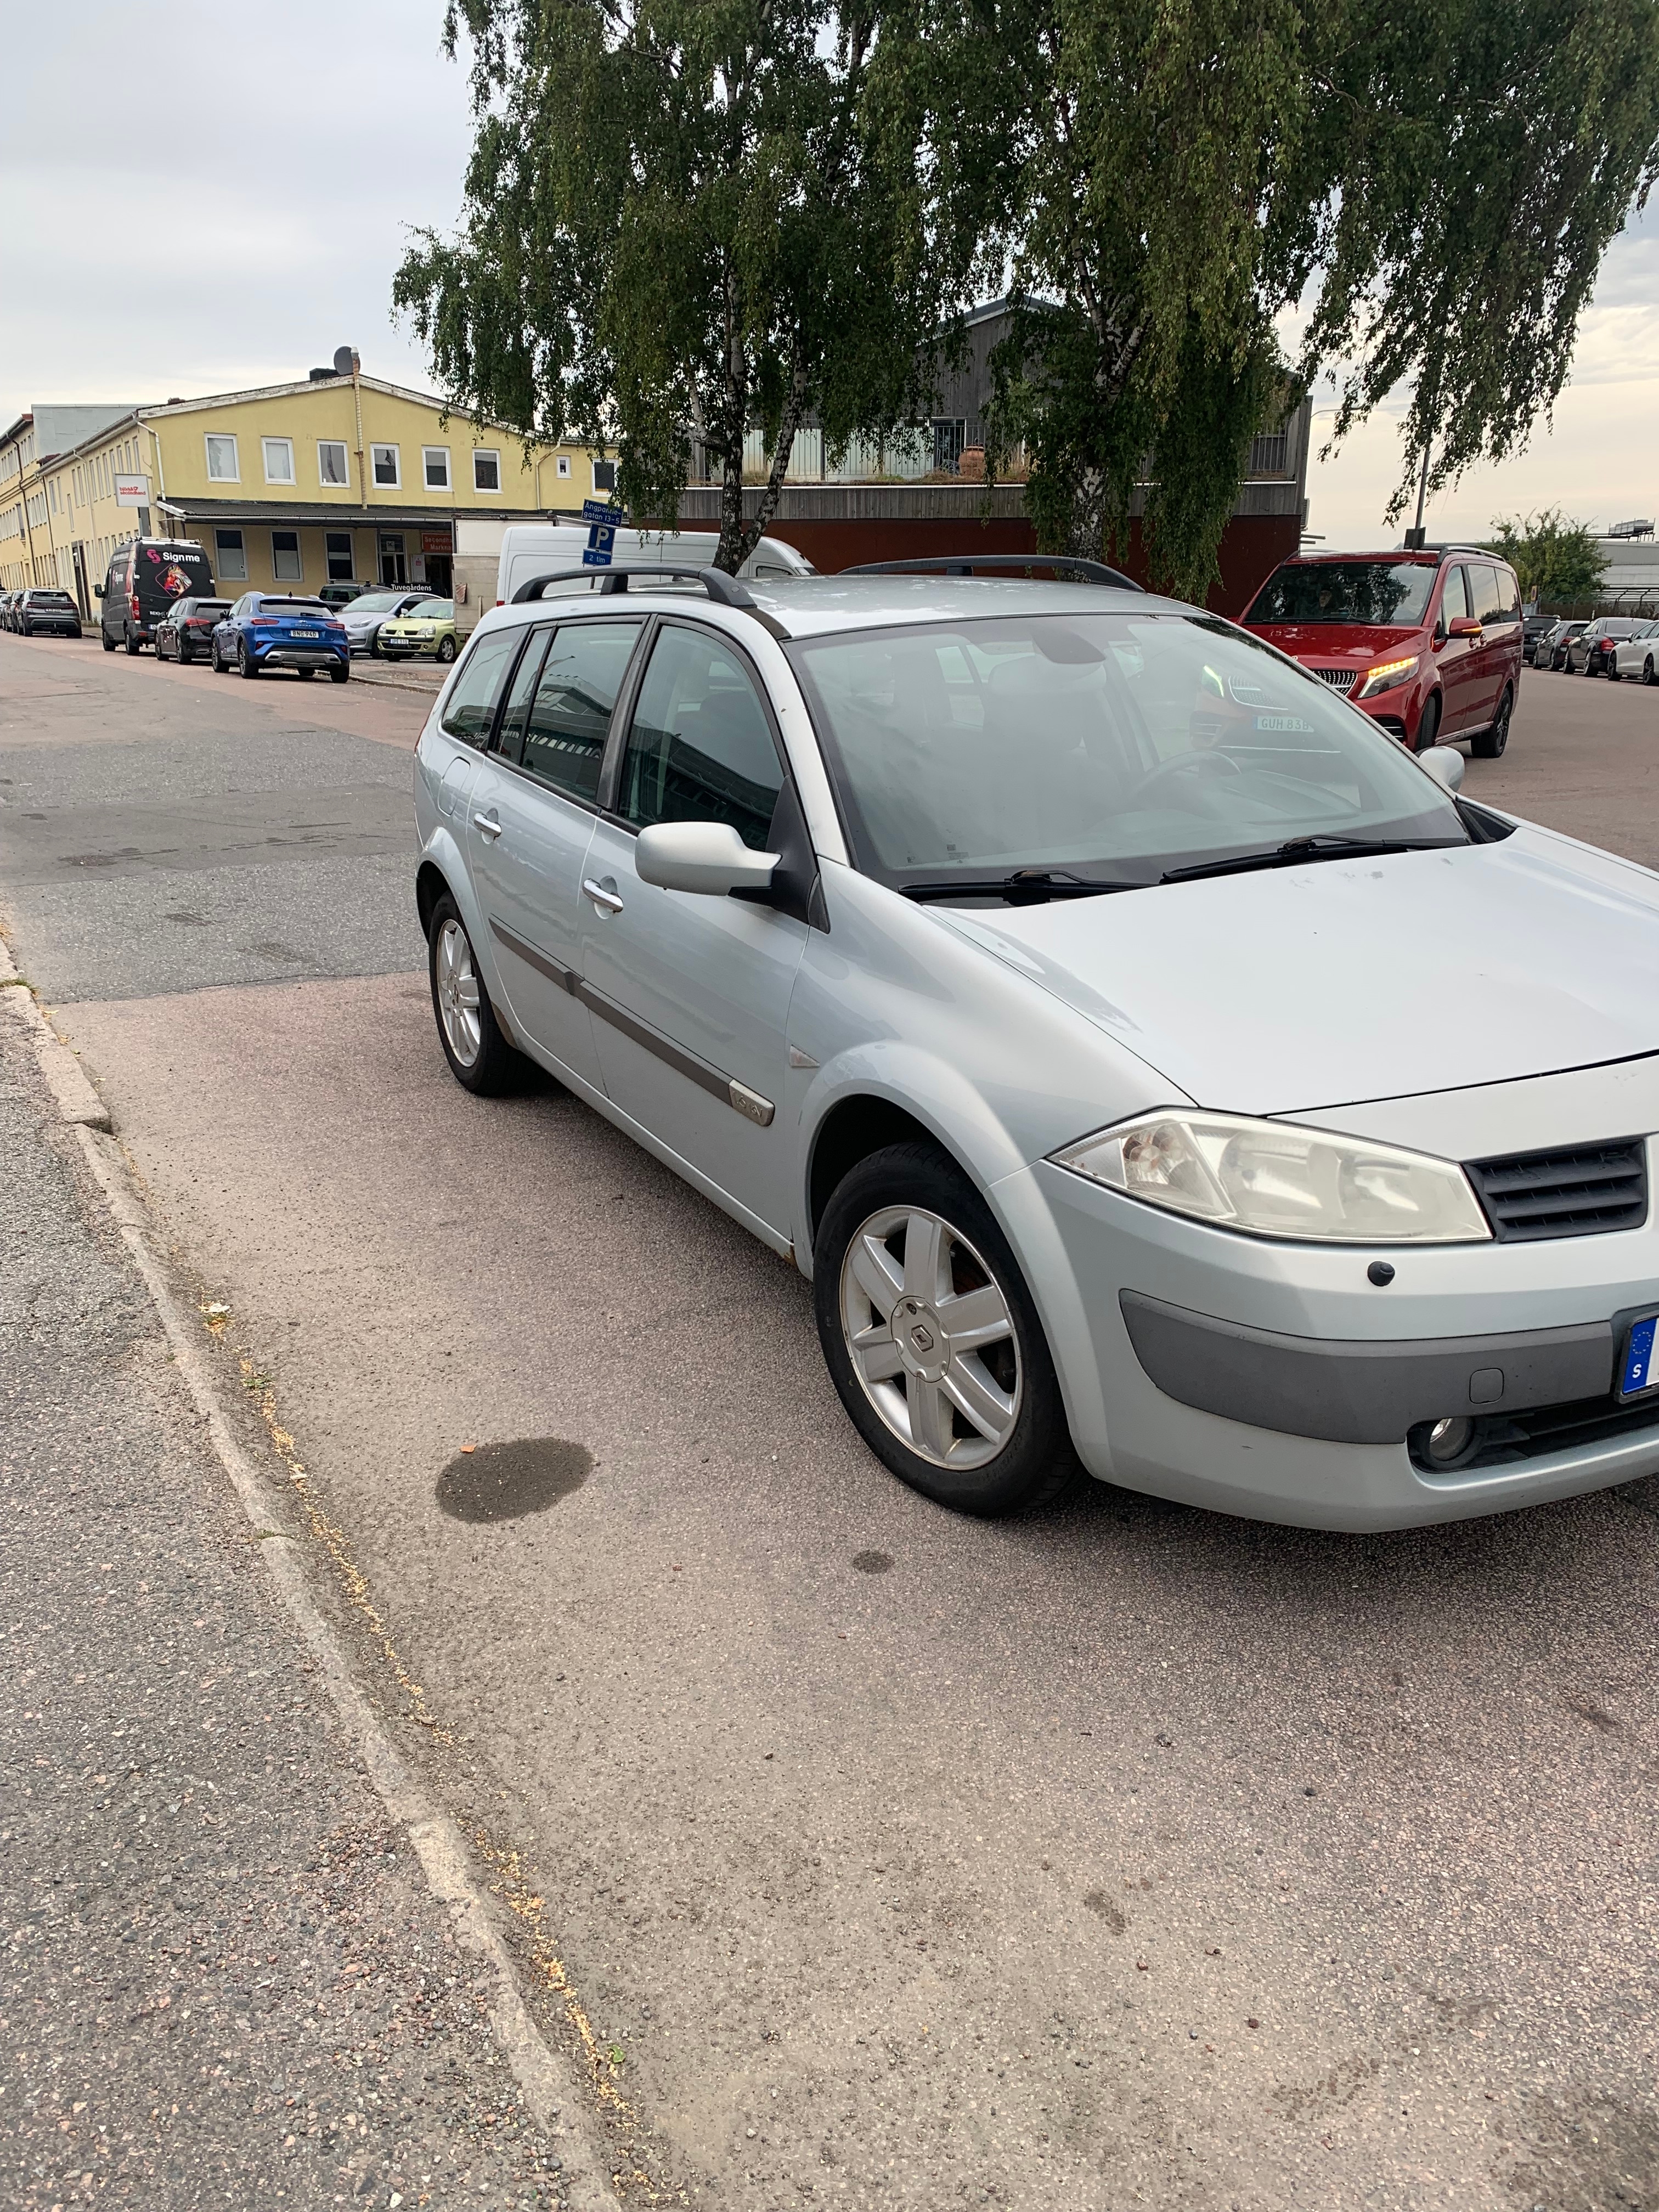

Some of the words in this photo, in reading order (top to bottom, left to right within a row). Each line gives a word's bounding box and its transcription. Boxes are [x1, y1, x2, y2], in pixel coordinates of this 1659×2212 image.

[583, 511, 603, 520] gatan
[595, 527, 610, 548] P
[1262, 718, 1283, 729] GUH
[1632, 1363, 1642, 1379] S
